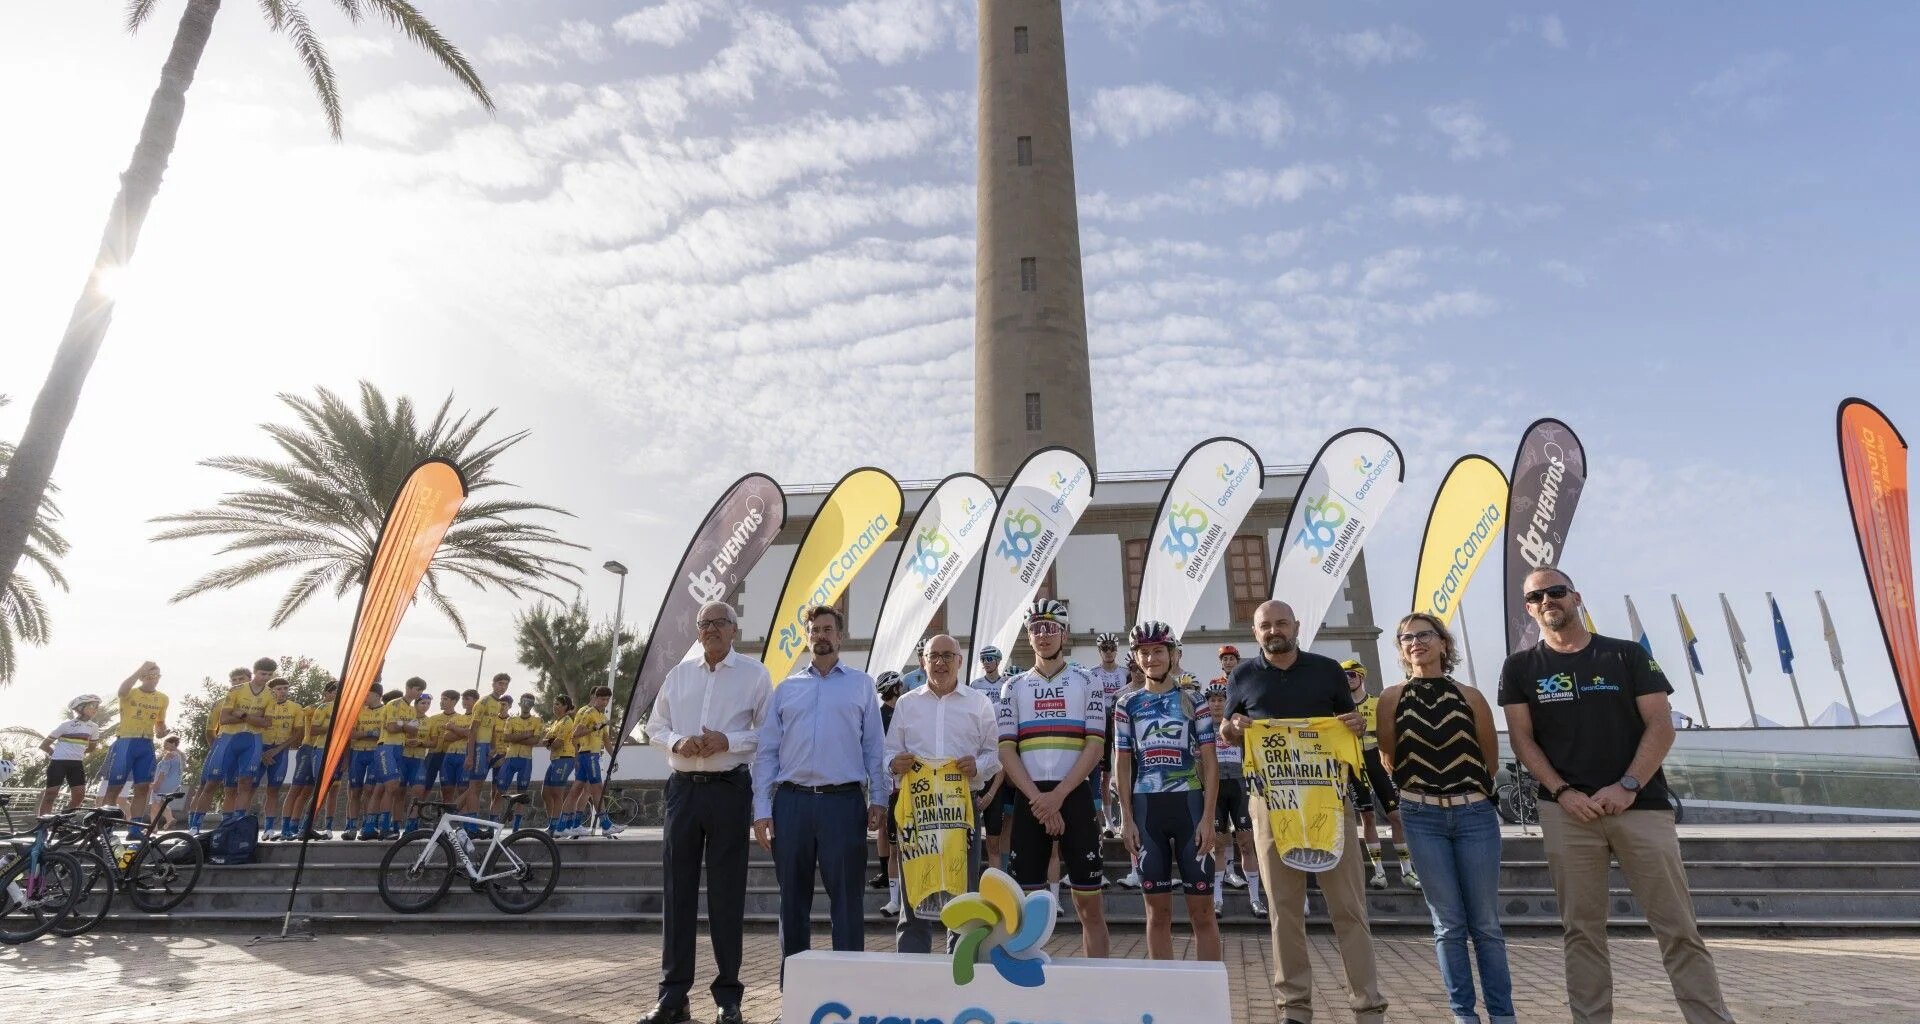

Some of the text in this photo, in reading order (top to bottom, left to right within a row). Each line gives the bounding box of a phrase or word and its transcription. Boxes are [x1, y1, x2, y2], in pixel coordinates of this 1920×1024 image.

[1051, 467, 1086, 514] GranCanaria
[1217, 457, 1254, 507] GranCanaria
[1356, 449, 1395, 501] GranCanaria
[1533, 456, 1565, 533] EVENTOS
[712, 508, 763, 575] EVENTOS
[959, 497, 994, 537] GranCanaria
[995, 507, 1042, 576] 365
[1159, 501, 1209, 570] 365
[1293, 494, 1345, 565] 365
[1020, 529, 1055, 584] GRAN CANARIA
[1186, 523, 1222, 580] GRAN CANARIA
[1322, 517, 1360, 574] GRAN CANARIA
[1432, 503, 1500, 614] GranCanaria
[924, 578, 941, 600] GRAN
[937, 551, 960, 581] CANARIA
[1034, 687, 1064, 699] UAE
[1536, 672, 1573, 693] 365
[1145, 757, 1181, 765] SOUDAL
[1262, 733, 1286, 748] 365
[1265, 749, 1300, 763] GRAN
[911, 778, 930, 794] 365
[1267, 764, 1322, 778] CANARIA
[914, 793, 943, 808] GRAN
[917, 807, 962, 823] CANARIA
